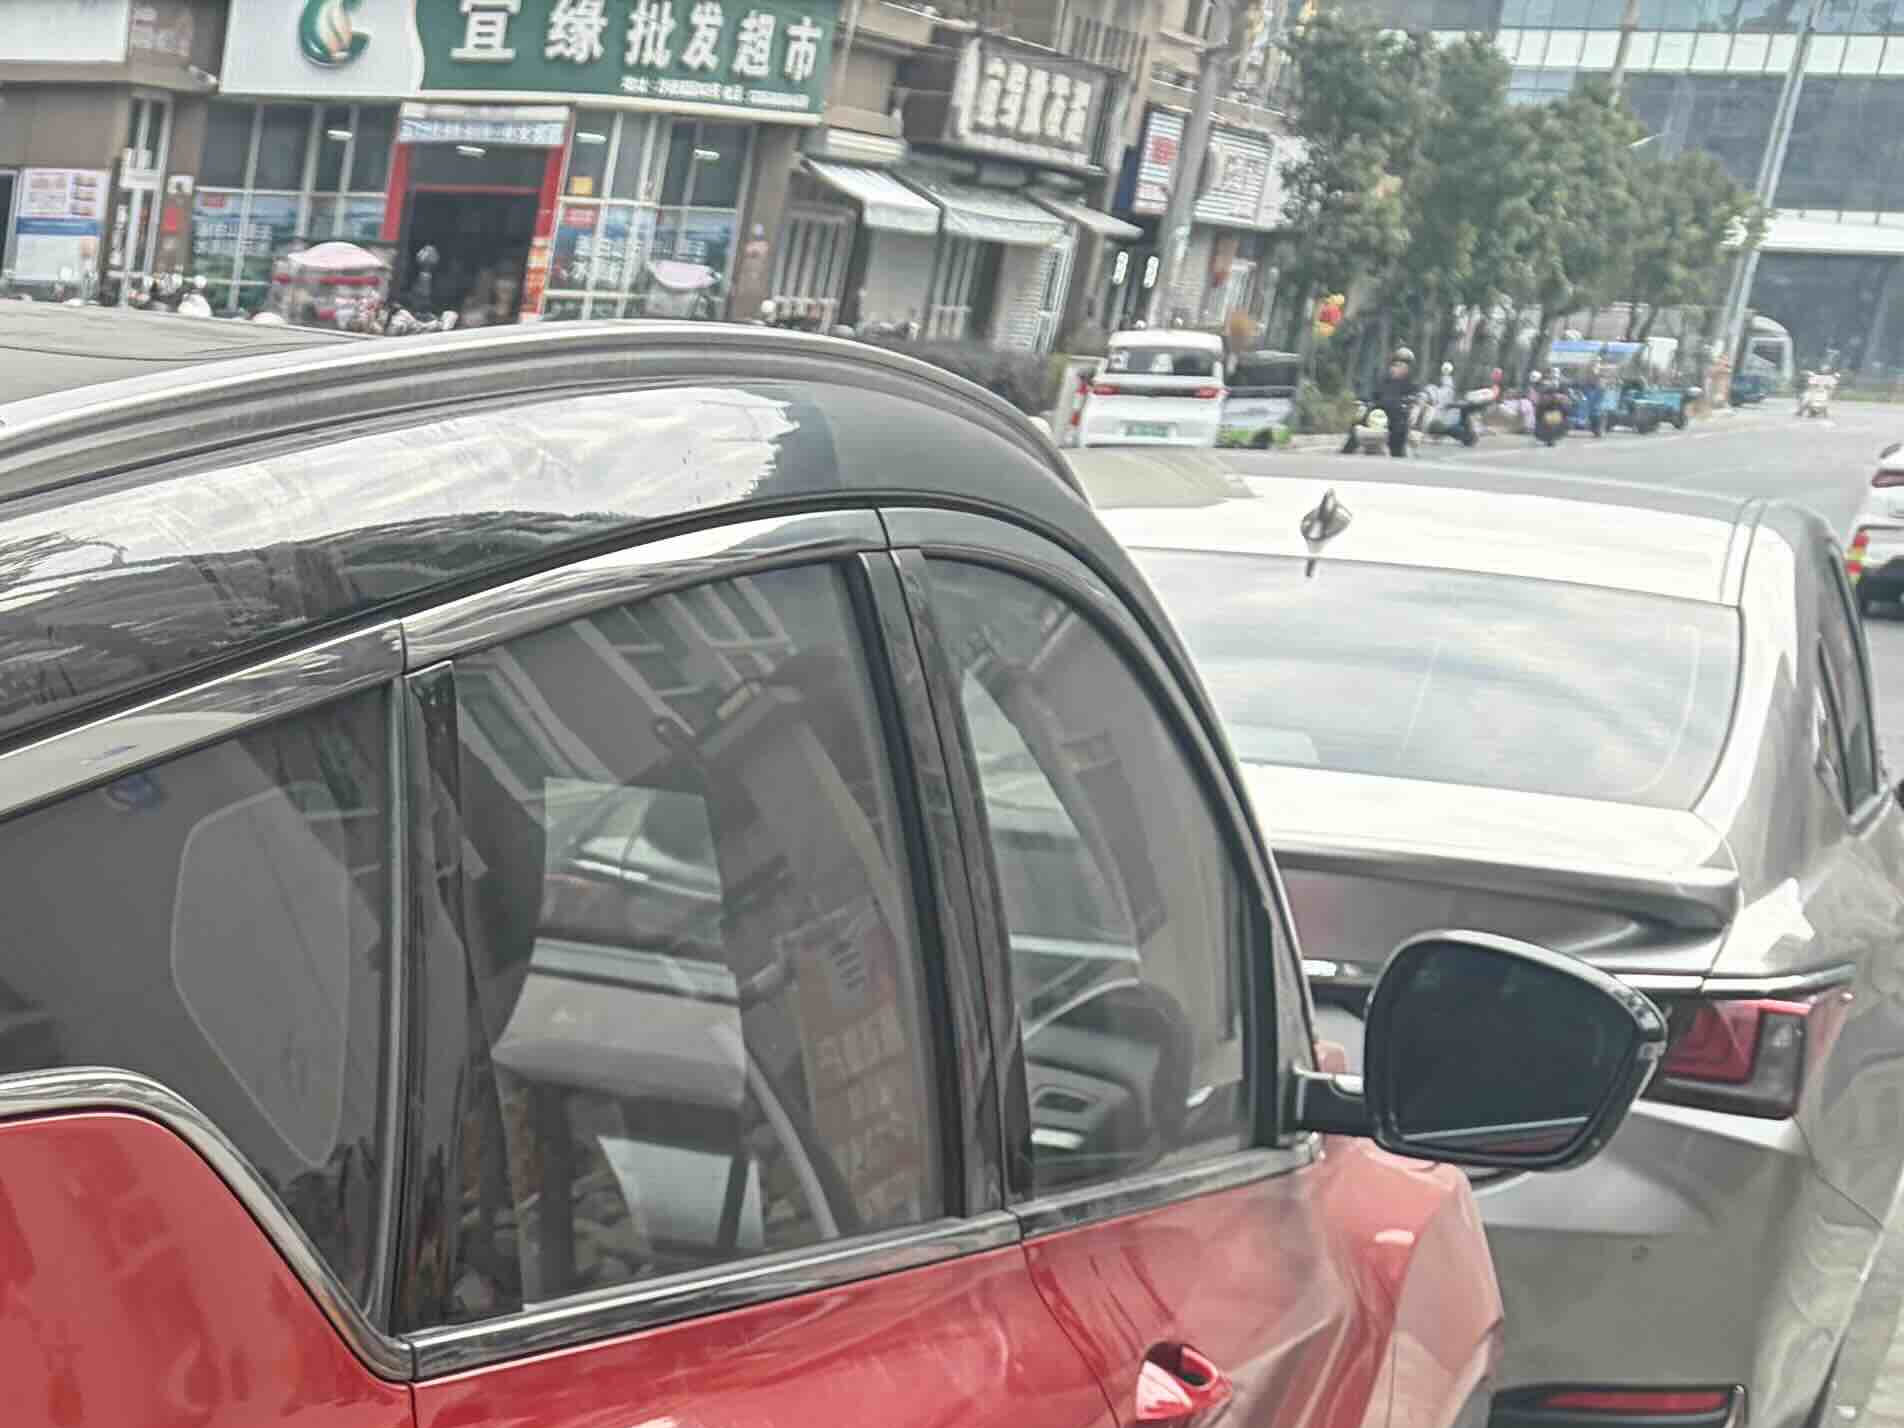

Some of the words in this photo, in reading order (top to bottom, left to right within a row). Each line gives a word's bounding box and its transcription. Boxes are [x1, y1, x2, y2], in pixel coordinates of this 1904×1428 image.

[450, 0, 824, 82] 宜缘批发超市
